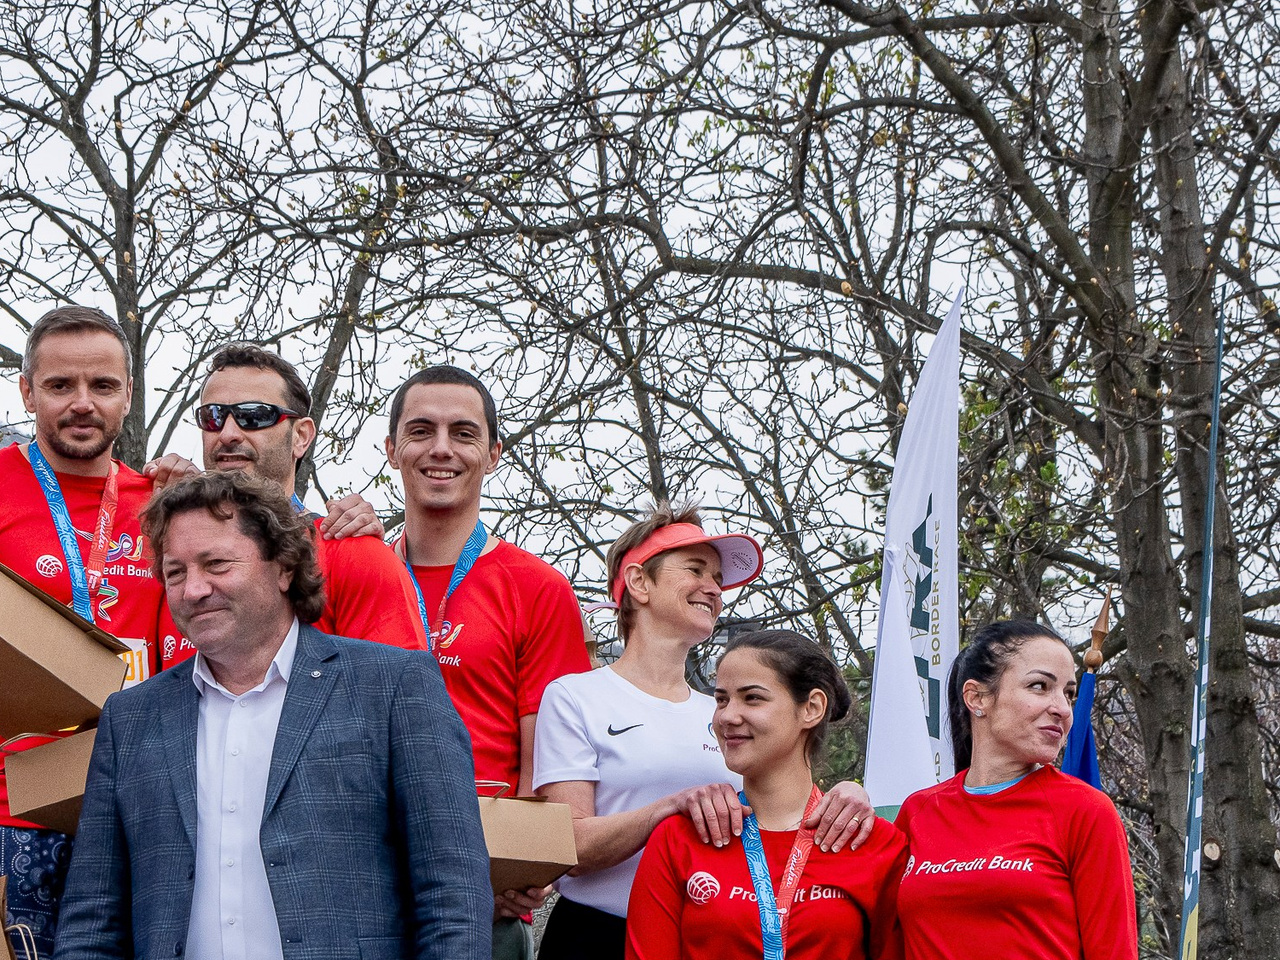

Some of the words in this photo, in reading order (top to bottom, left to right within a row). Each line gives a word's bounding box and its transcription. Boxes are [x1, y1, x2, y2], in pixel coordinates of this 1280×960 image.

[933, 519, 941, 573] RACE
[127, 564, 154, 579] Bank
[931, 580, 941, 666] BORDER
[438, 652, 462, 667] ank
[915, 858, 988, 876] ProCredit
[987, 855, 1034, 872] Bank
